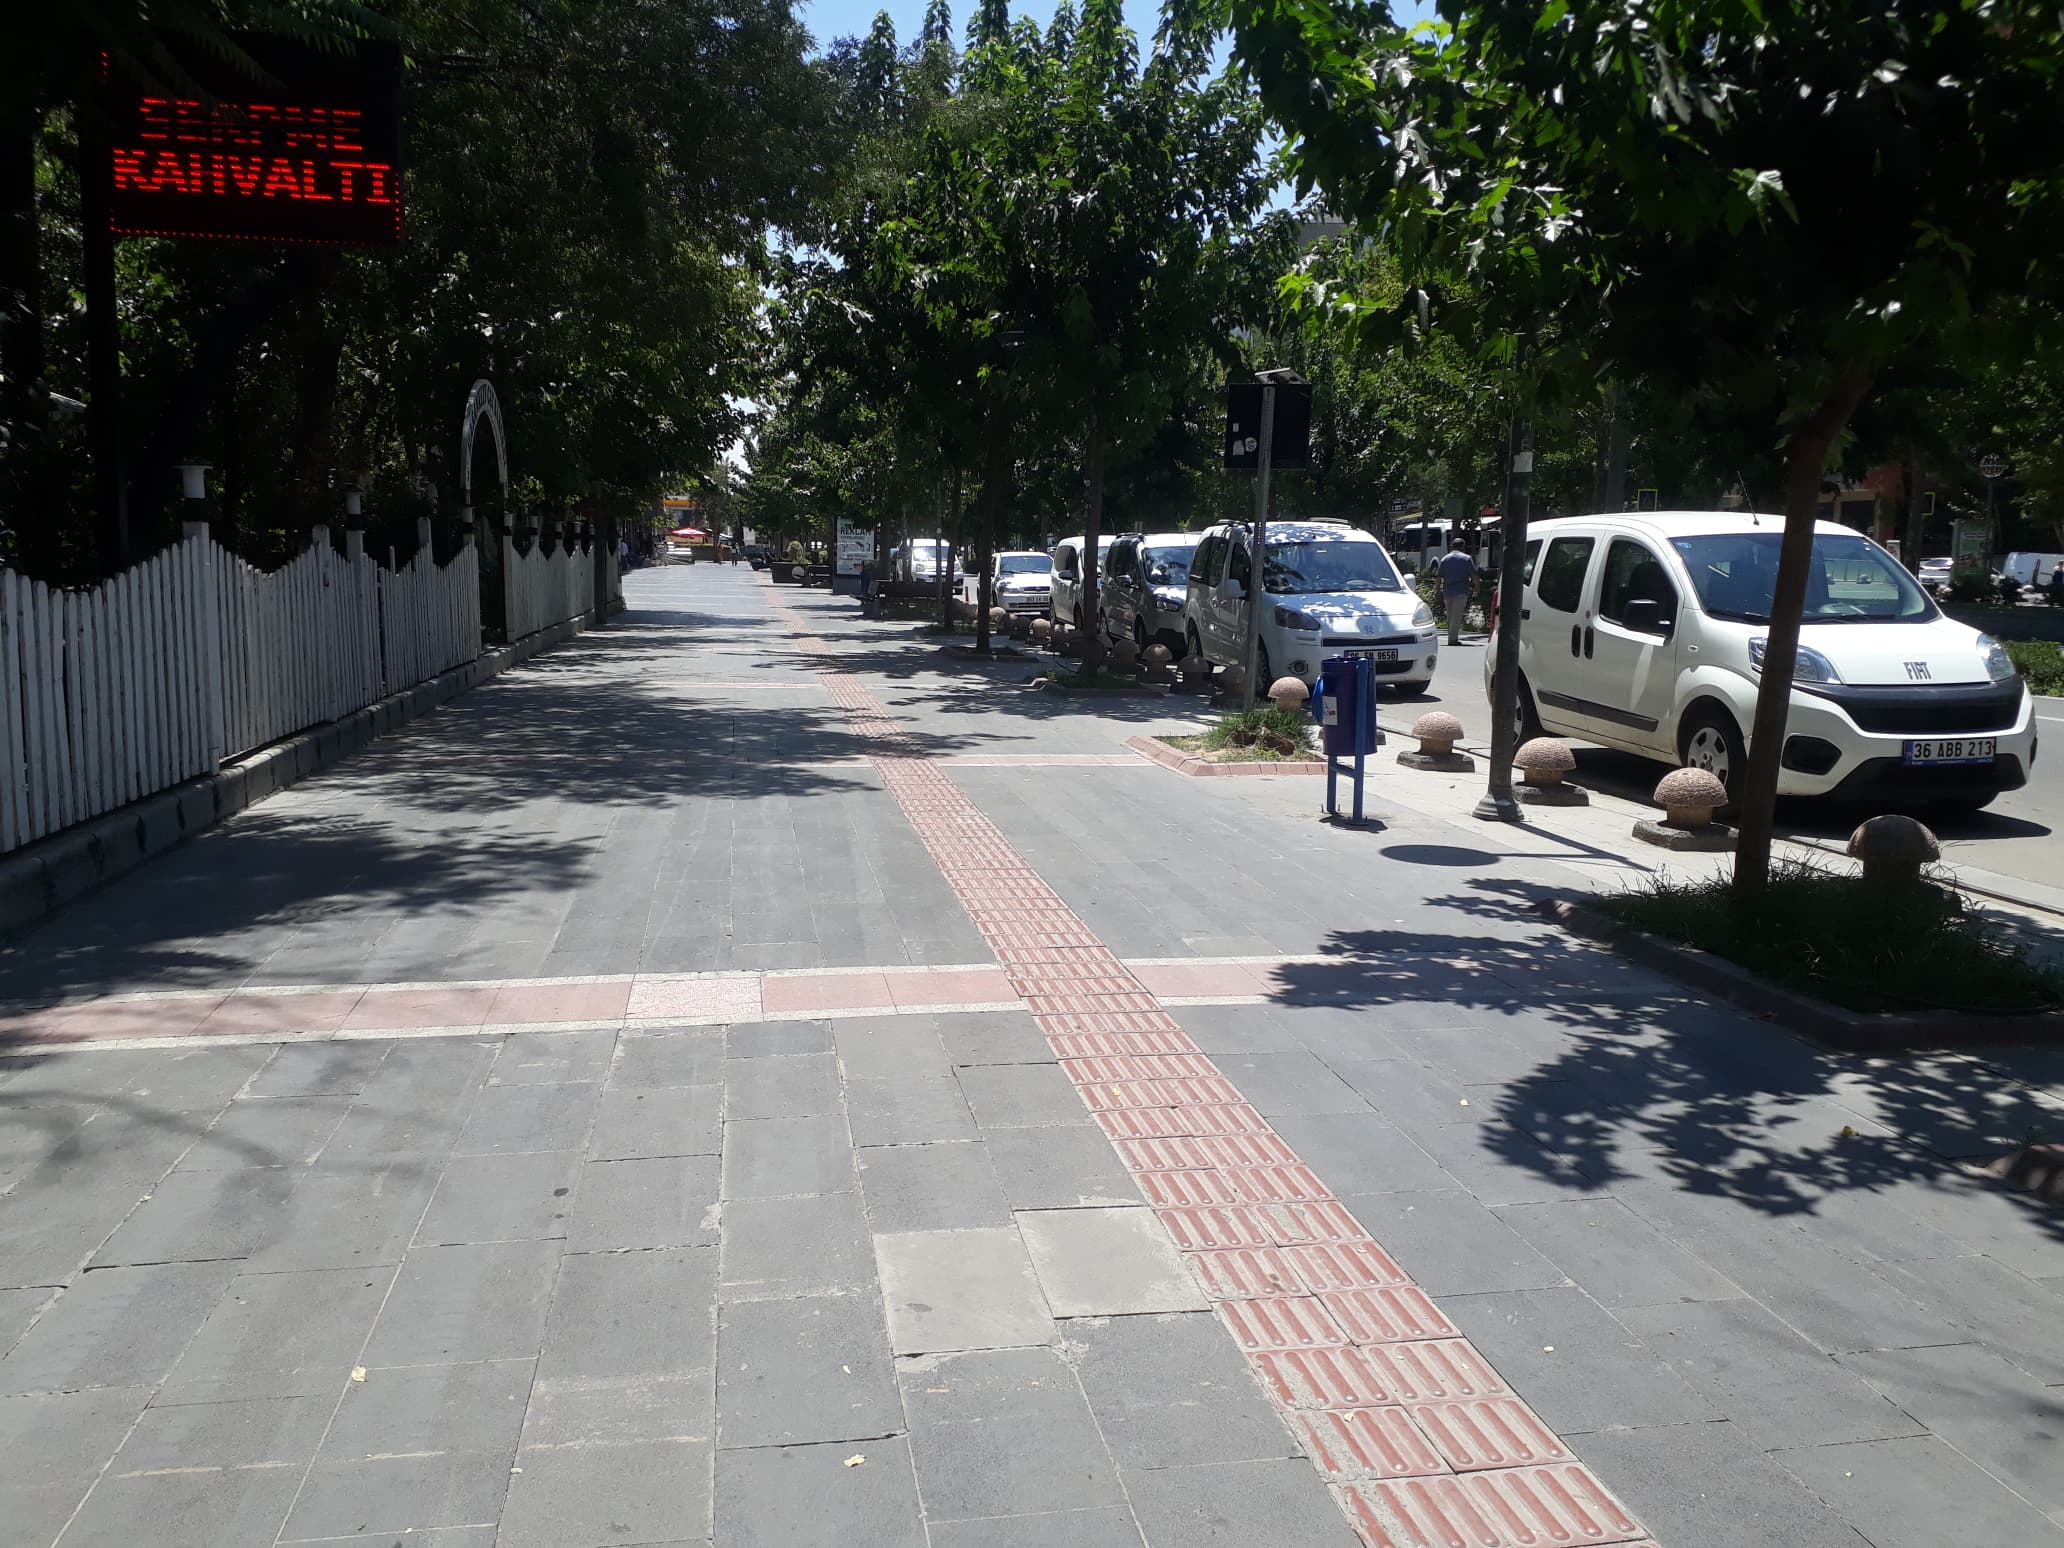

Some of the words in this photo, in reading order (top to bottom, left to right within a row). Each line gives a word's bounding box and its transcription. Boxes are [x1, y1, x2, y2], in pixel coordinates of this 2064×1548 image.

[112, 148, 391, 203] KAHVALTI
[1903, 661, 1932, 680] FIAT
[1914, 743, 1931, 758] 36
[1937, 742, 1962, 757] ABB
[1968, 741, 1992, 756] 213
